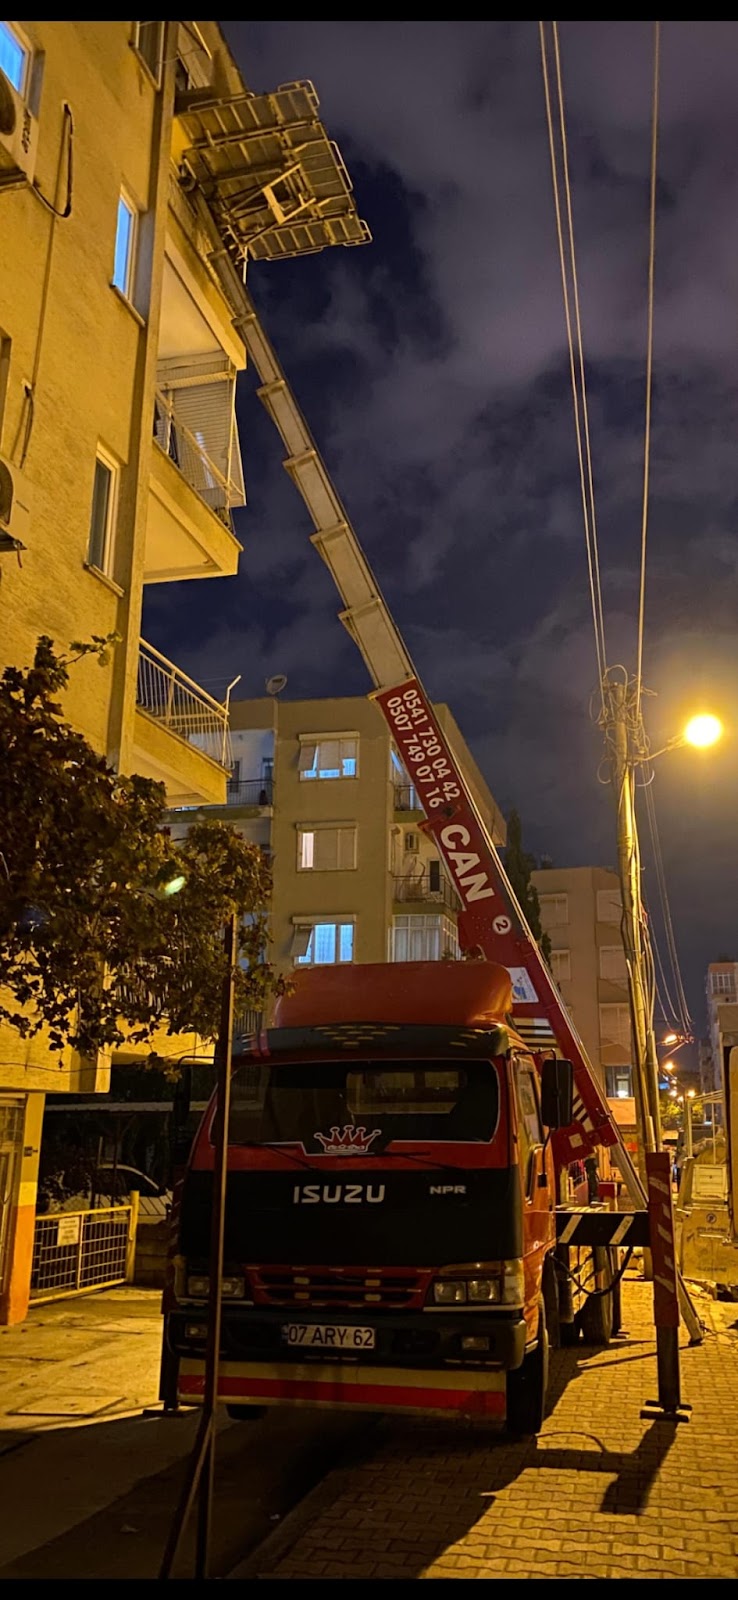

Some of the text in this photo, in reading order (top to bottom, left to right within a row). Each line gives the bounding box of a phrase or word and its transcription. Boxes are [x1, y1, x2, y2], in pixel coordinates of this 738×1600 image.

[387, 697, 445, 808] 0507 749 07 16
[402, 689, 460, 802] 0541 730 04 42
[440, 824, 495, 903] CAN
[293, 1185, 386, 1204] ISUZU
[429, 1185, 467, 1195] NPR
[288, 1325, 373, 1346] 07 ARY 62
